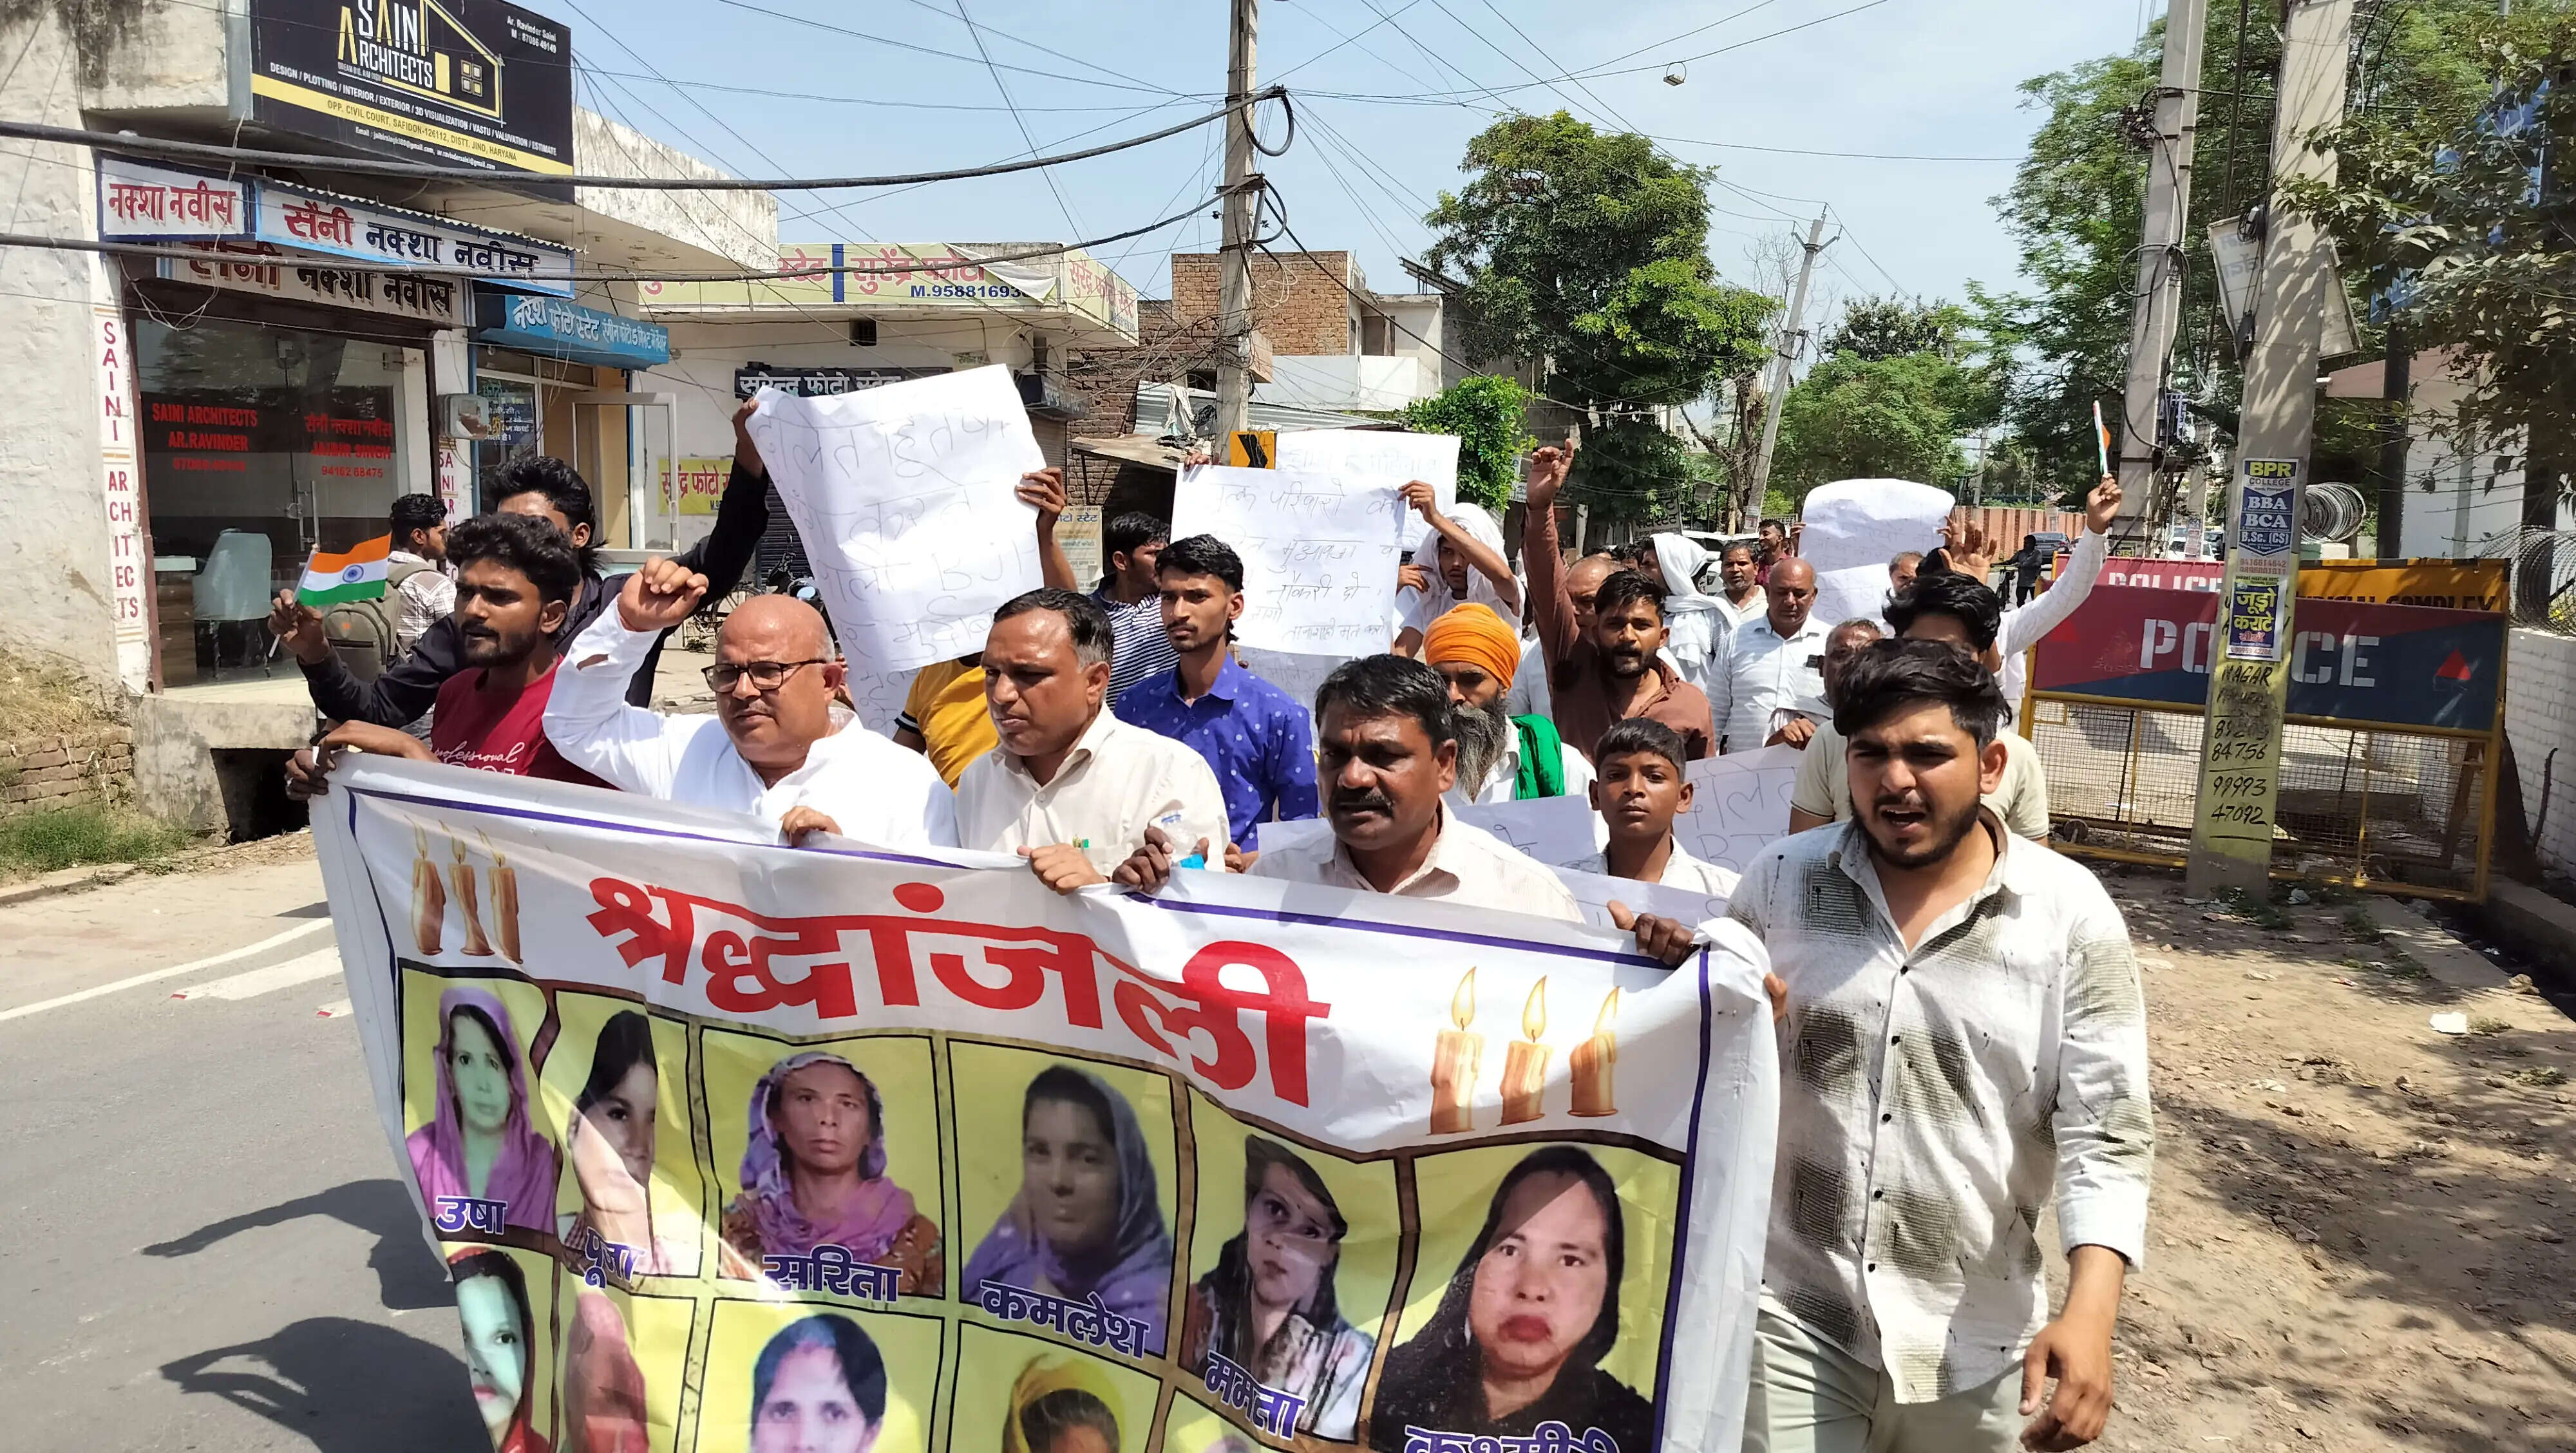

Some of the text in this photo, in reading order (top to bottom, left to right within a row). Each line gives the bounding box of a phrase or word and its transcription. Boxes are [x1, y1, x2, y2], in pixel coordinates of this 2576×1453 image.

[337, 6, 433, 88] ARCHITECTS
[358, 0, 426, 57] SAINI
[516, 19, 541, 36] Ravinder
[542, 29, 556, 43] Saini
[270, 62, 298, 79] DESIGN
[303, 72, 337, 92] PLOTTING
[343, 84, 375, 103] INTERIOR
[379, 95, 411, 114] EXTERIOR
[415, 107, 424, 117] 3D
[424, 108, 468, 131] VISUALIZATION
[473, 122, 491, 137] VASTU
[532, 140, 557, 156] ESTIMATE
[327, 100, 344, 112] OPP.
[346, 105, 364, 118] CIVIL
[366, 111, 391, 126] COURT,
[451, 137, 470, 149] DISTT.
[471, 141, 488, 154] JIND,
[489, 146, 517, 161] HARYANA
[109, 180, 236, 225] नक्शा नवीस
[282, 200, 538, 274] सैनी नक्शा नवीस
[513, 296, 547, 329] नरेश
[549, 302, 575, 336] फोटो
[575, 309, 600, 341] स्टेट
[153, 403, 257, 426] SAINI ARCHITECTS
[692, 464, 719, 495] फोटो
[2250, 462, 2291, 477] BPR
[2244, 514, 2287, 527] BCA
[2248, 497, 2287, 509] BBA
[2269, 533, 2289, 544] (CS)
[2234, 611, 2274, 632] कराटे
[2222, 665, 2273, 687] NAGAR
[2211, 803, 2268, 825] 47092
[585, 877, 1331, 1106] श्रद्धांजली
[435, 1195, 507, 1237] उषा
[583, 1225, 645, 1287] पूजा
[762, 1244, 902, 1303] सरिता
[978, 1277, 1151, 1359] कमलेश
[1204, 1350, 1307, 1439] ममता
